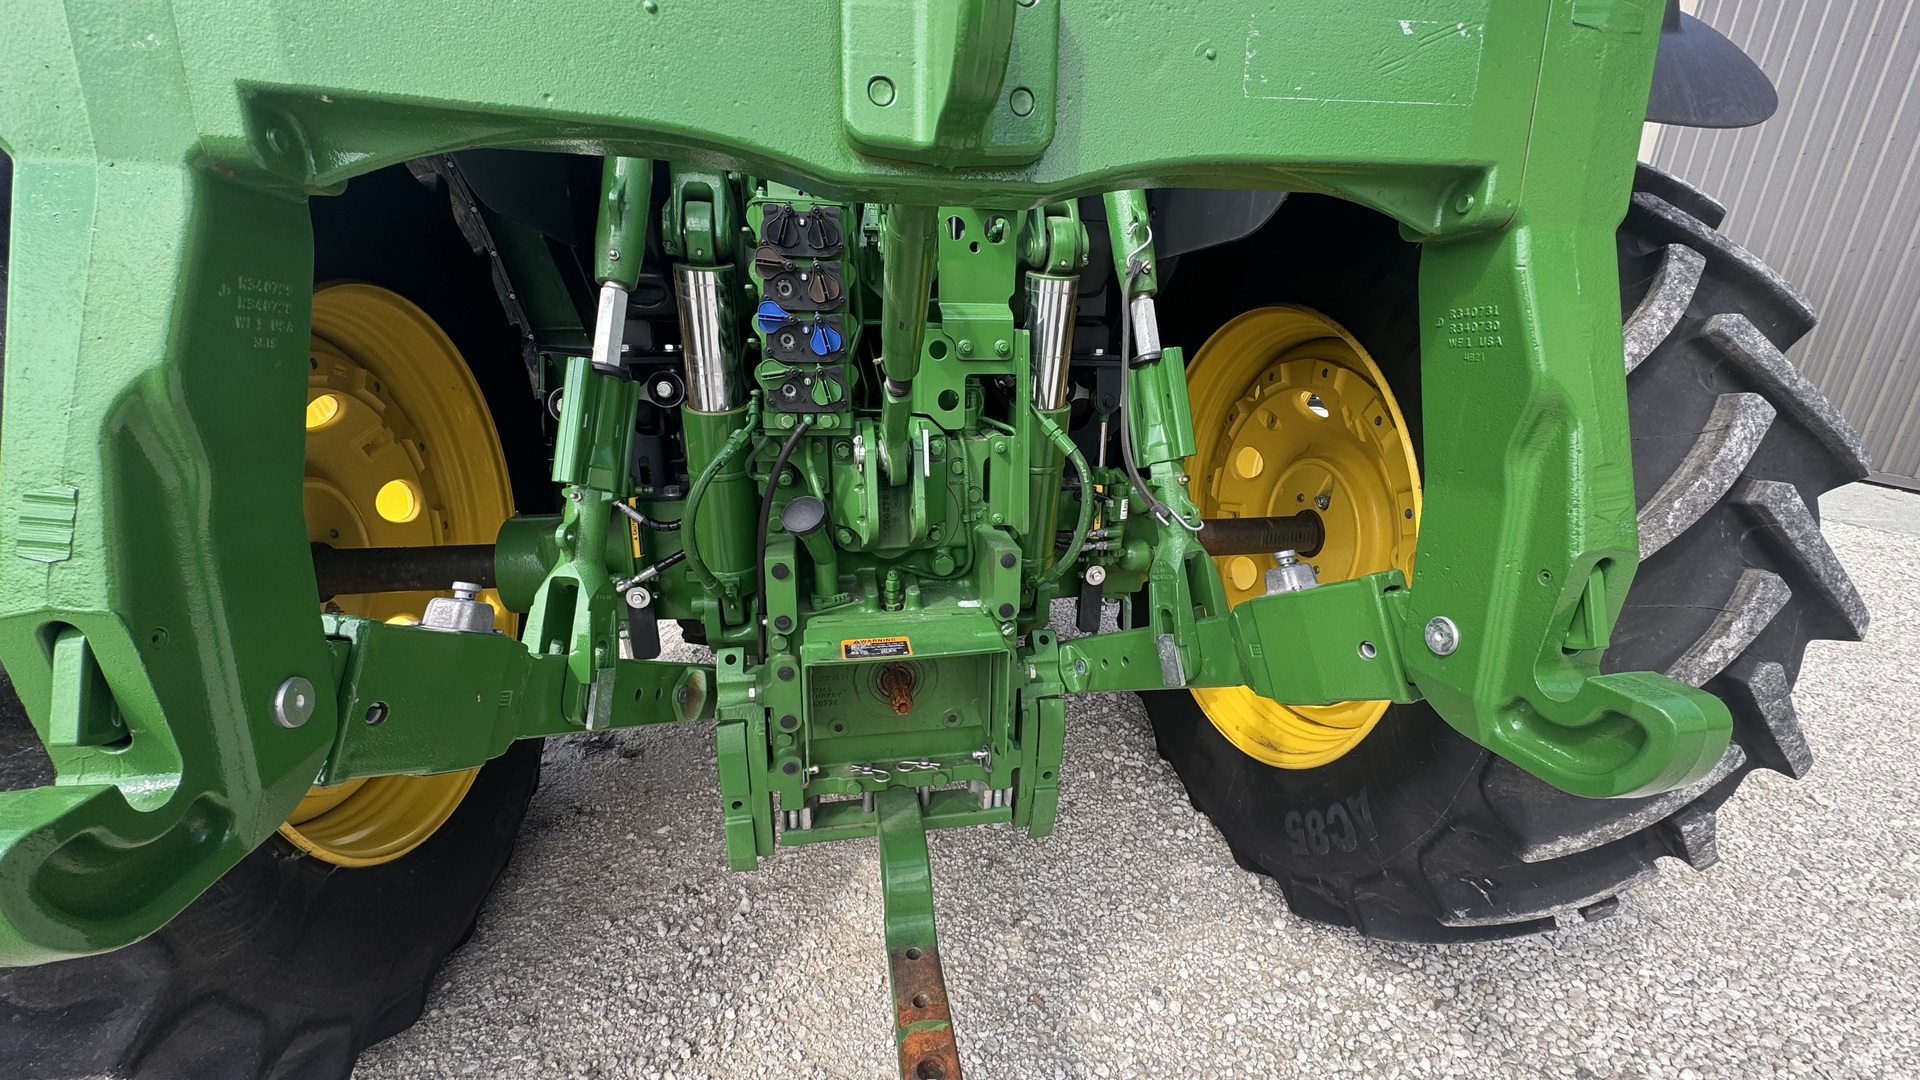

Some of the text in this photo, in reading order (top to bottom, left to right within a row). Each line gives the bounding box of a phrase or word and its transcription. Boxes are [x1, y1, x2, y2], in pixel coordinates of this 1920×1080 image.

[1449, 305, 1499, 320] R340731
[1449, 320, 1500, 335] R340730
[1479, 336, 1503, 348] USA
[859, 637, 896, 645] WARNING
[1284, 784, 1378, 856] AC85
